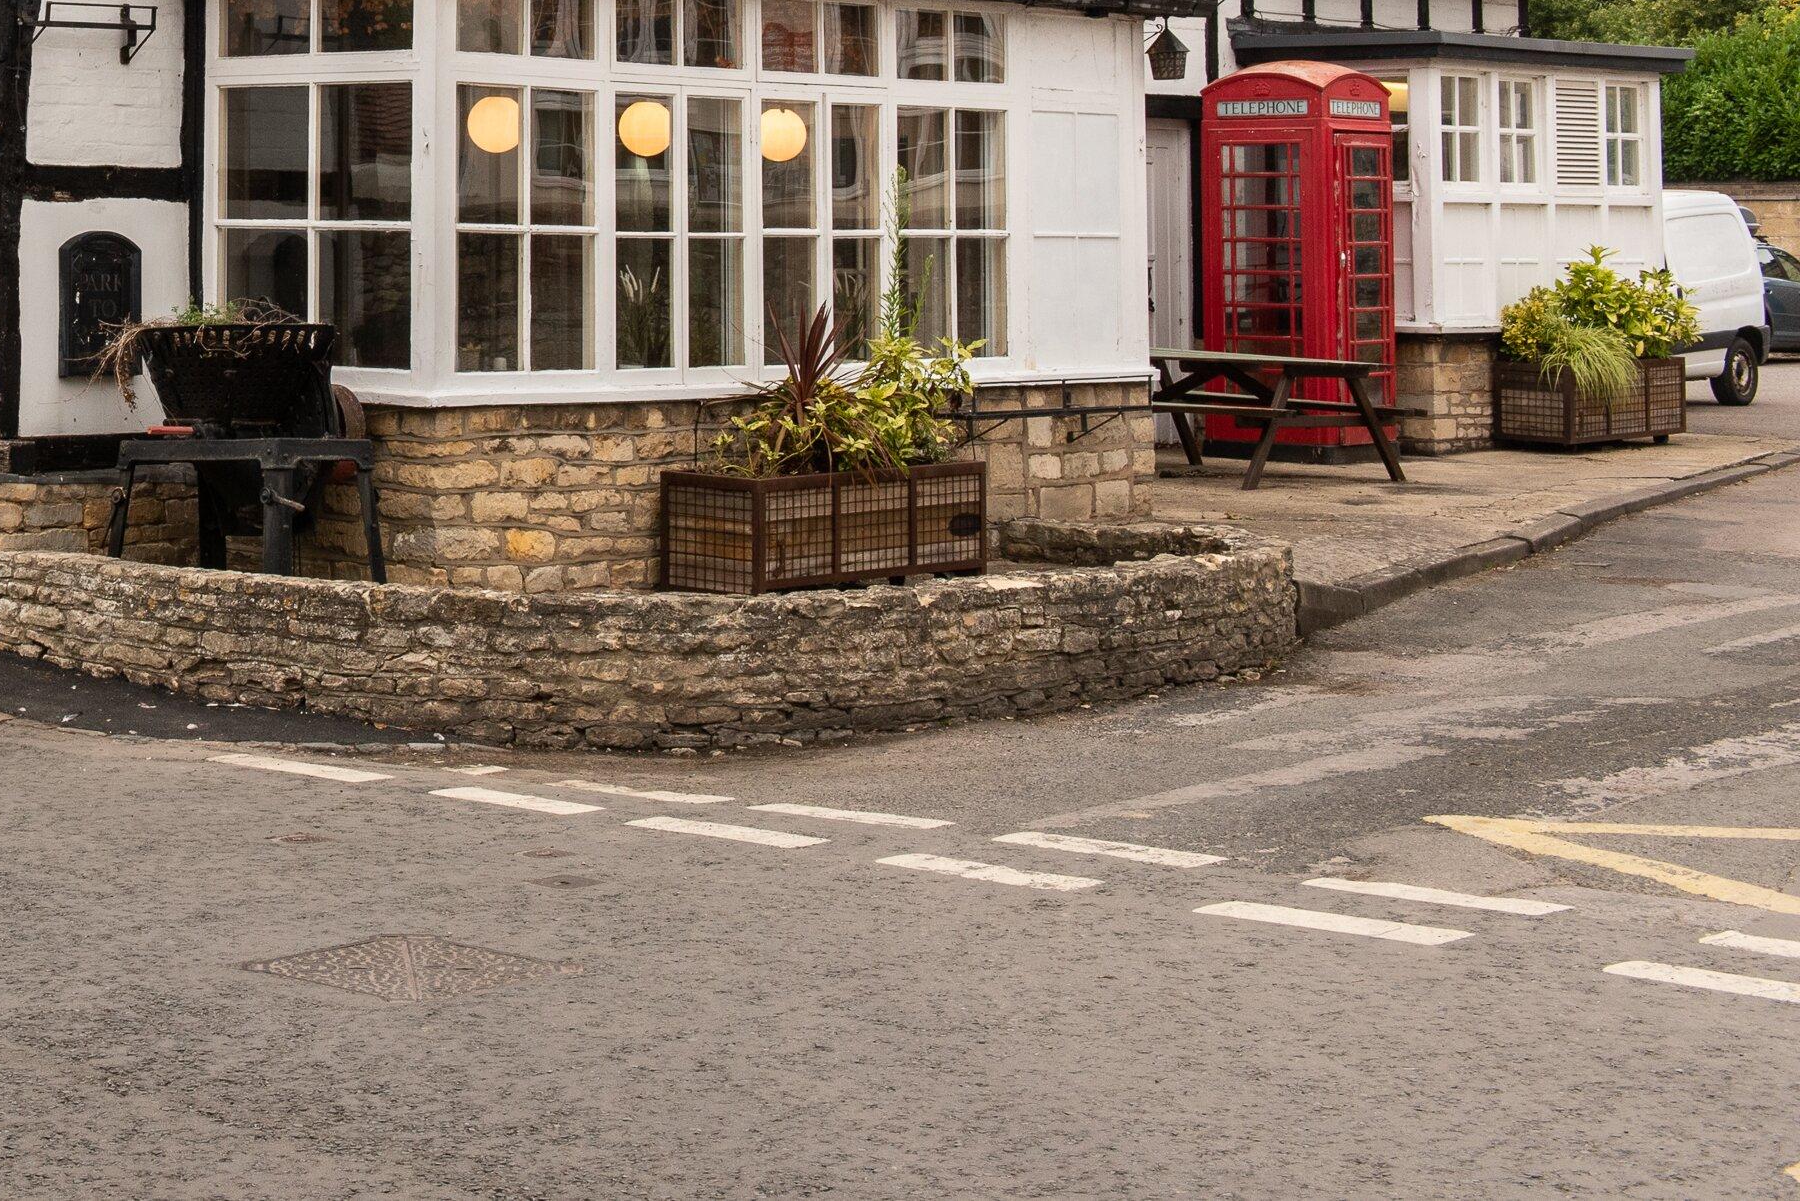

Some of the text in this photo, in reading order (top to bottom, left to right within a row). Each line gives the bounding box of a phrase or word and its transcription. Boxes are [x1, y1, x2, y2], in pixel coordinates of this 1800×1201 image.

[1222, 101, 1304, 115] TELEPHONE
[1331, 101, 1380, 115] TELEPHONE
[88, 298, 117, 317] TO
